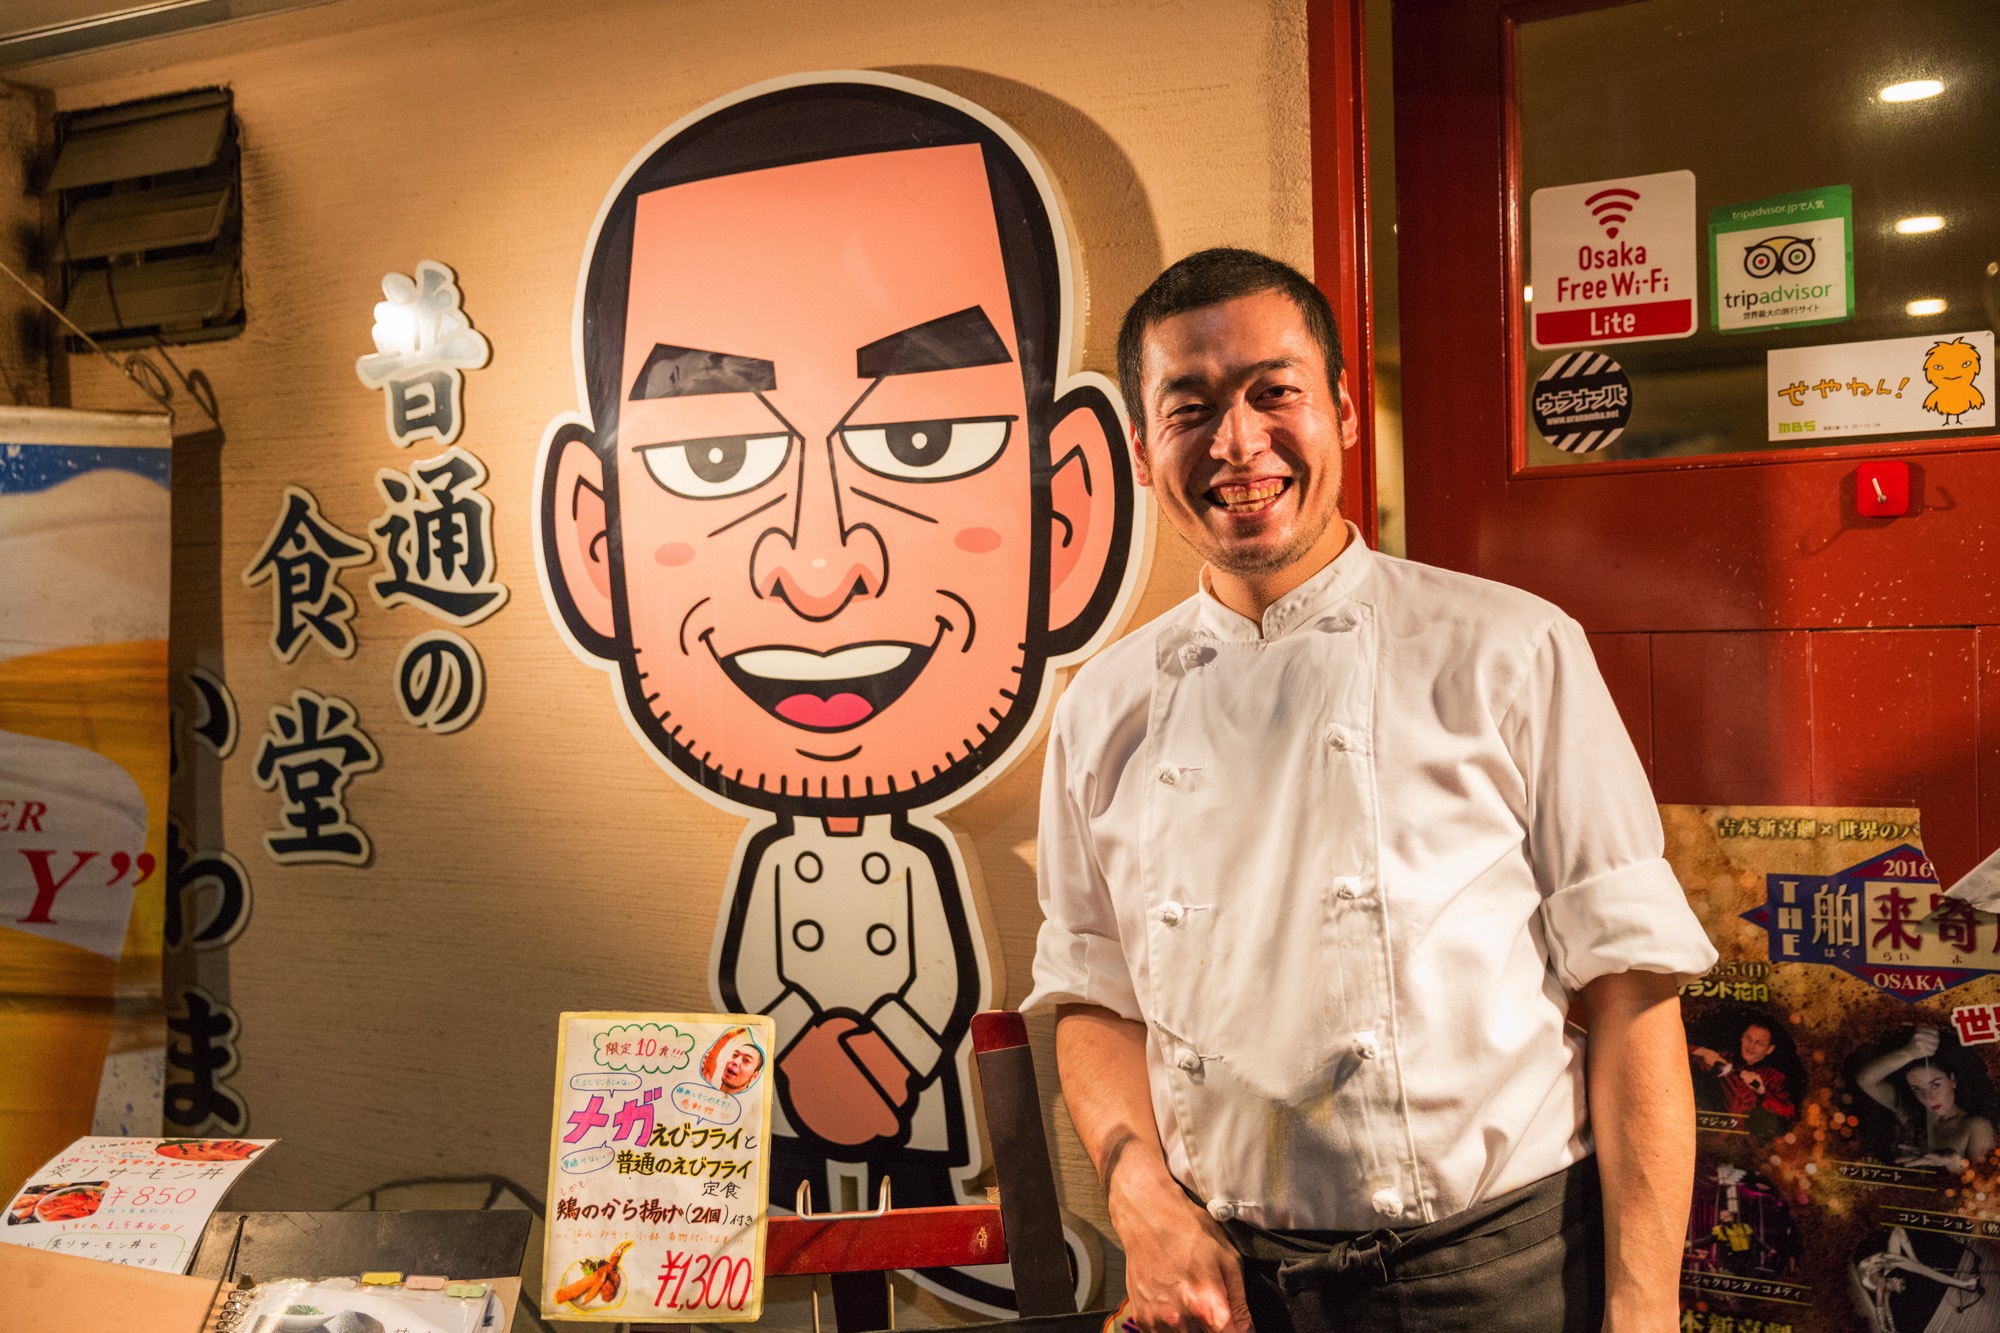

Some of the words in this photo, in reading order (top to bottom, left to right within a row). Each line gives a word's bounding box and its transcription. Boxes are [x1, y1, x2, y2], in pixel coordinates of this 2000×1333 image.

[1732, 200, 1825, 220] tripadvisor.jpで人気
[1578, 241, 1647, 271] Osaka
[1557, 277, 1608, 303] Free
[1611, 268, 1669, 297] Wi-Fi
[1724, 284, 1832, 310] tripadvisor
[1590, 311, 1636, 337] Lite
[1743, 304, 1820, 320] 世界最大の旅行サイト
[1536, 384, 1628, 416] ウラナンバ
[362, 266, 501, 727] 普通の
[249, 494, 370, 857] 食堂
[1882, 859, 1932, 879] 2016
[1777, 880, 1803, 956] THE
[1812, 883, 2000, 955] 舶来寄
[1873, 973, 1946, 991] OSAKA
[1955, 1005, 2000, 1043] 世
[616, 1150, 753, 1179] 普通のえびフライ
[1838, 1165, 1903, 1182] サンドアート
[110, 1186, 197, 1207] ¥850
[702, 1180, 742, 1200] 定食
